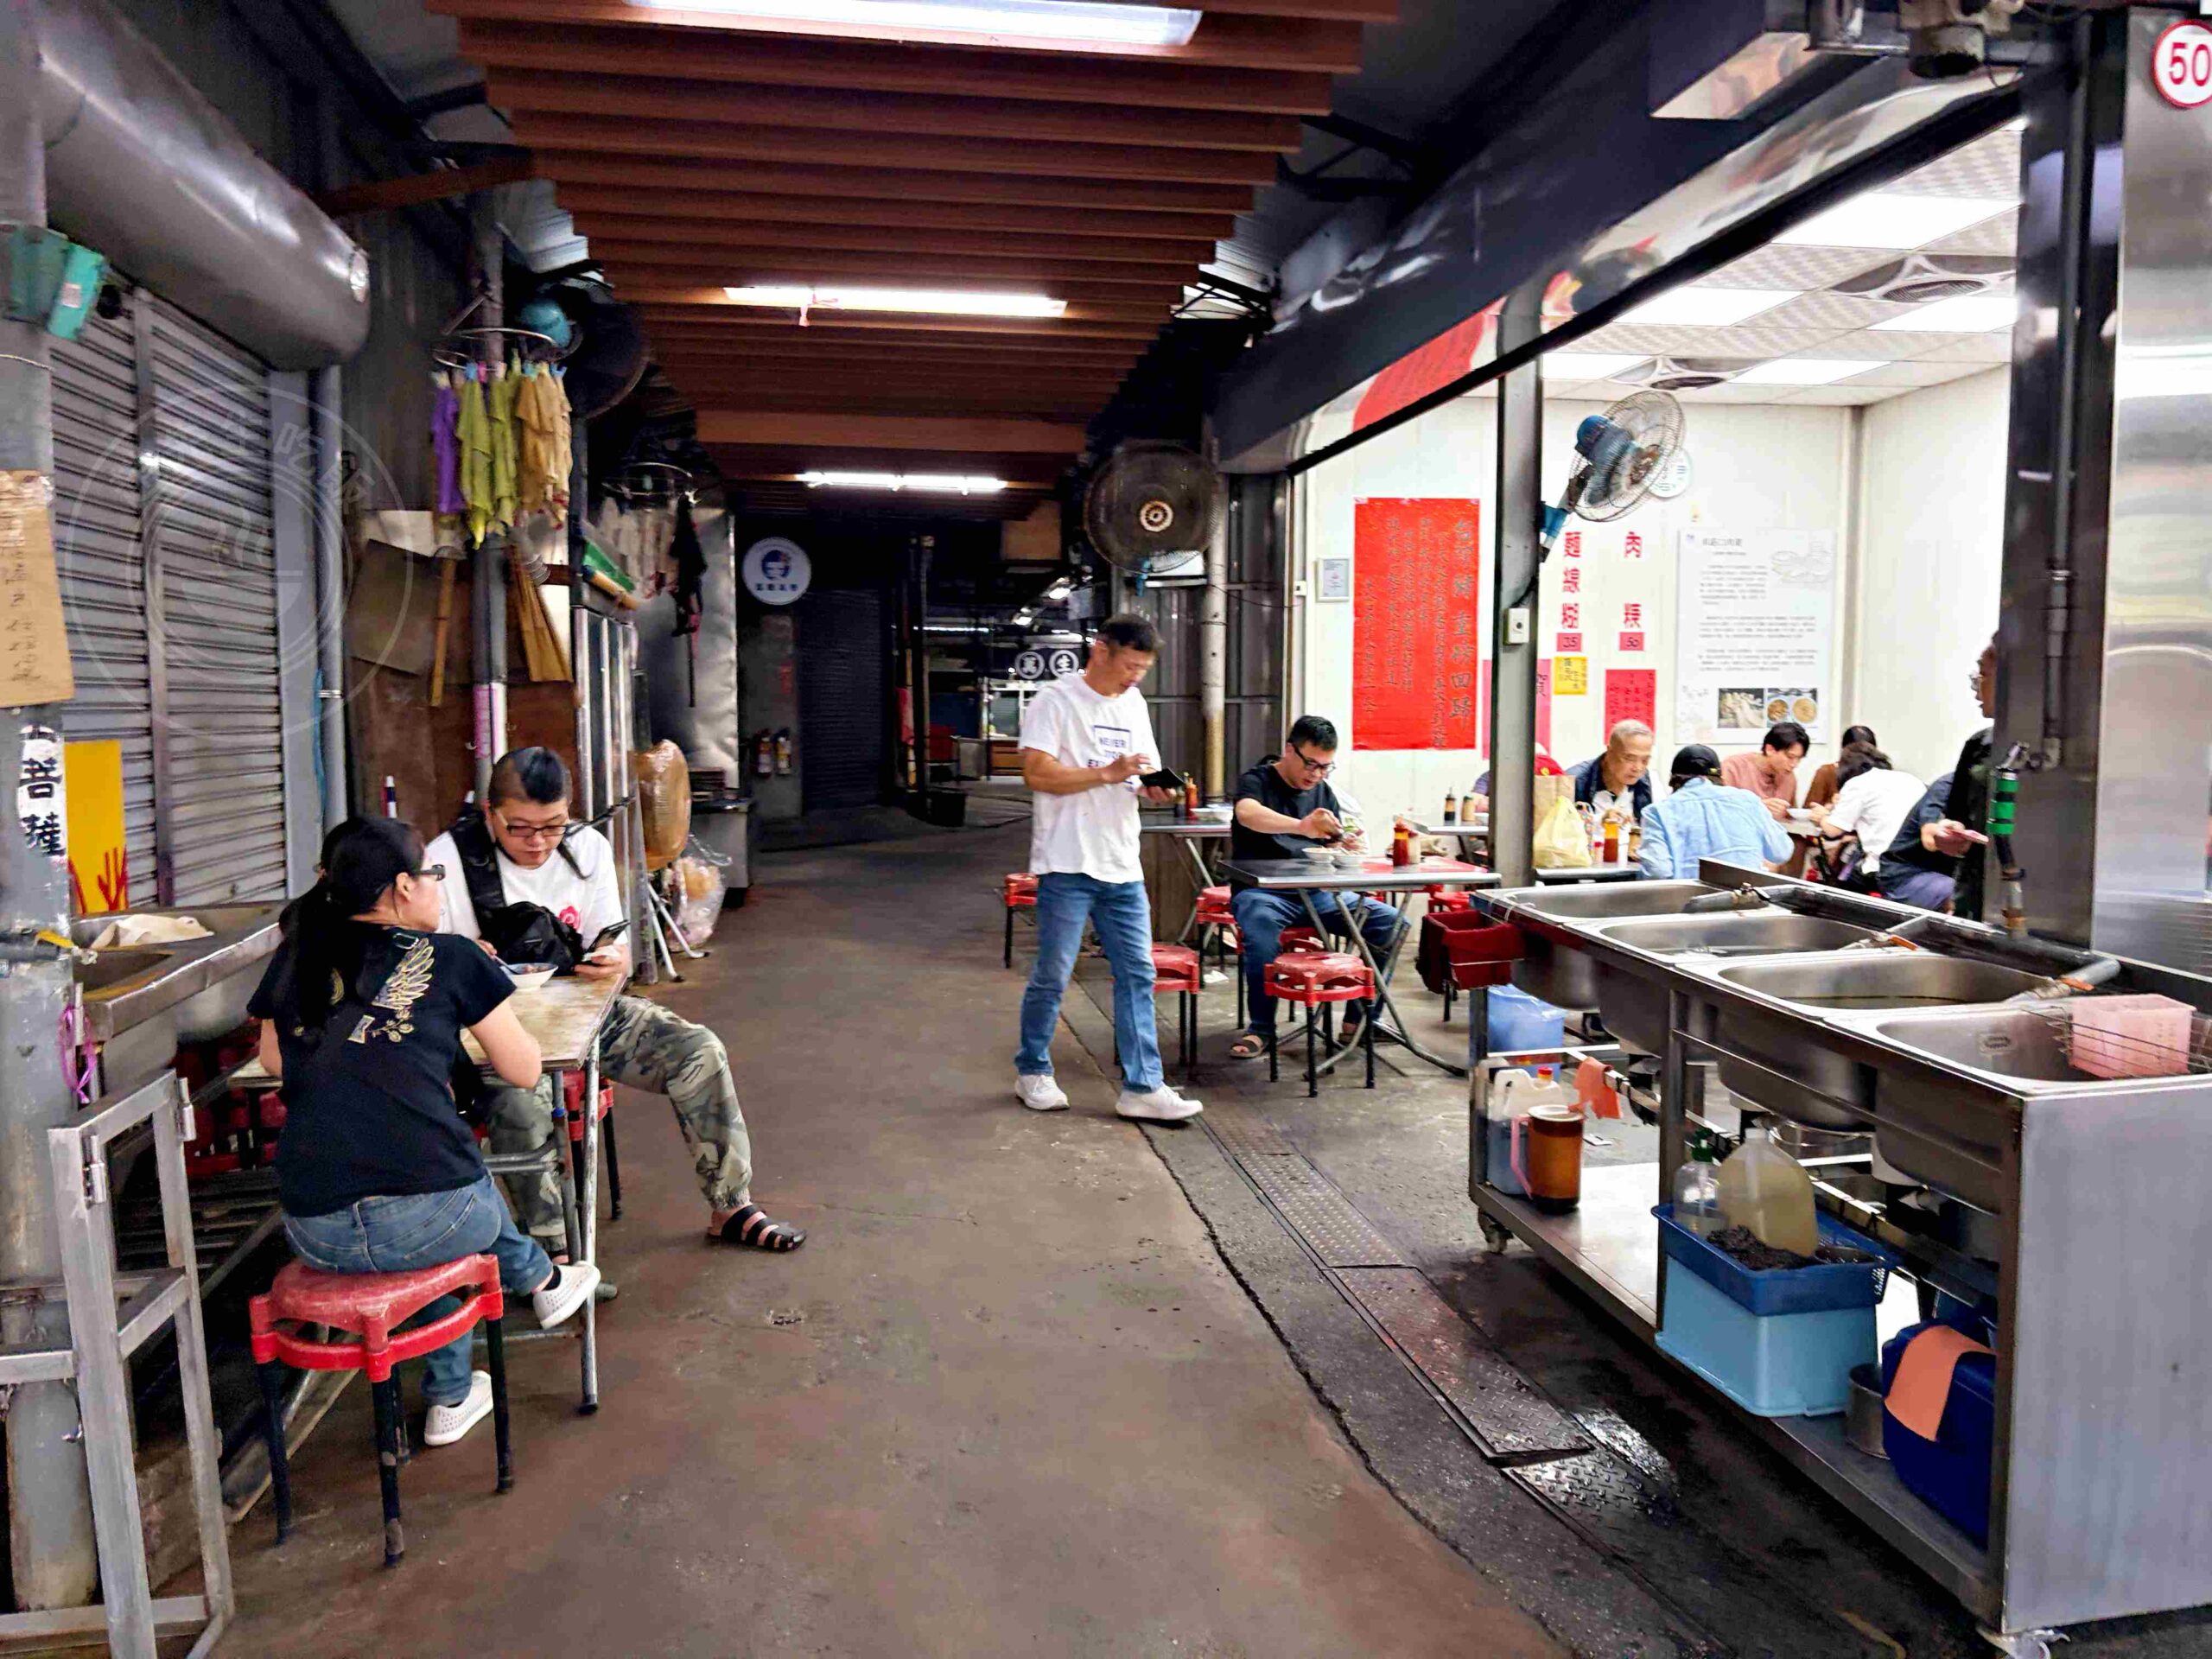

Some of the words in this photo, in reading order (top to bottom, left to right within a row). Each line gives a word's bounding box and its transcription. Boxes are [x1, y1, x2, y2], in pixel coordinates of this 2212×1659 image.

[2169, 42, 2212, 86] 50
[1562, 636, 1579, 649] 35
[18, 758, 67, 858] 菩薩
